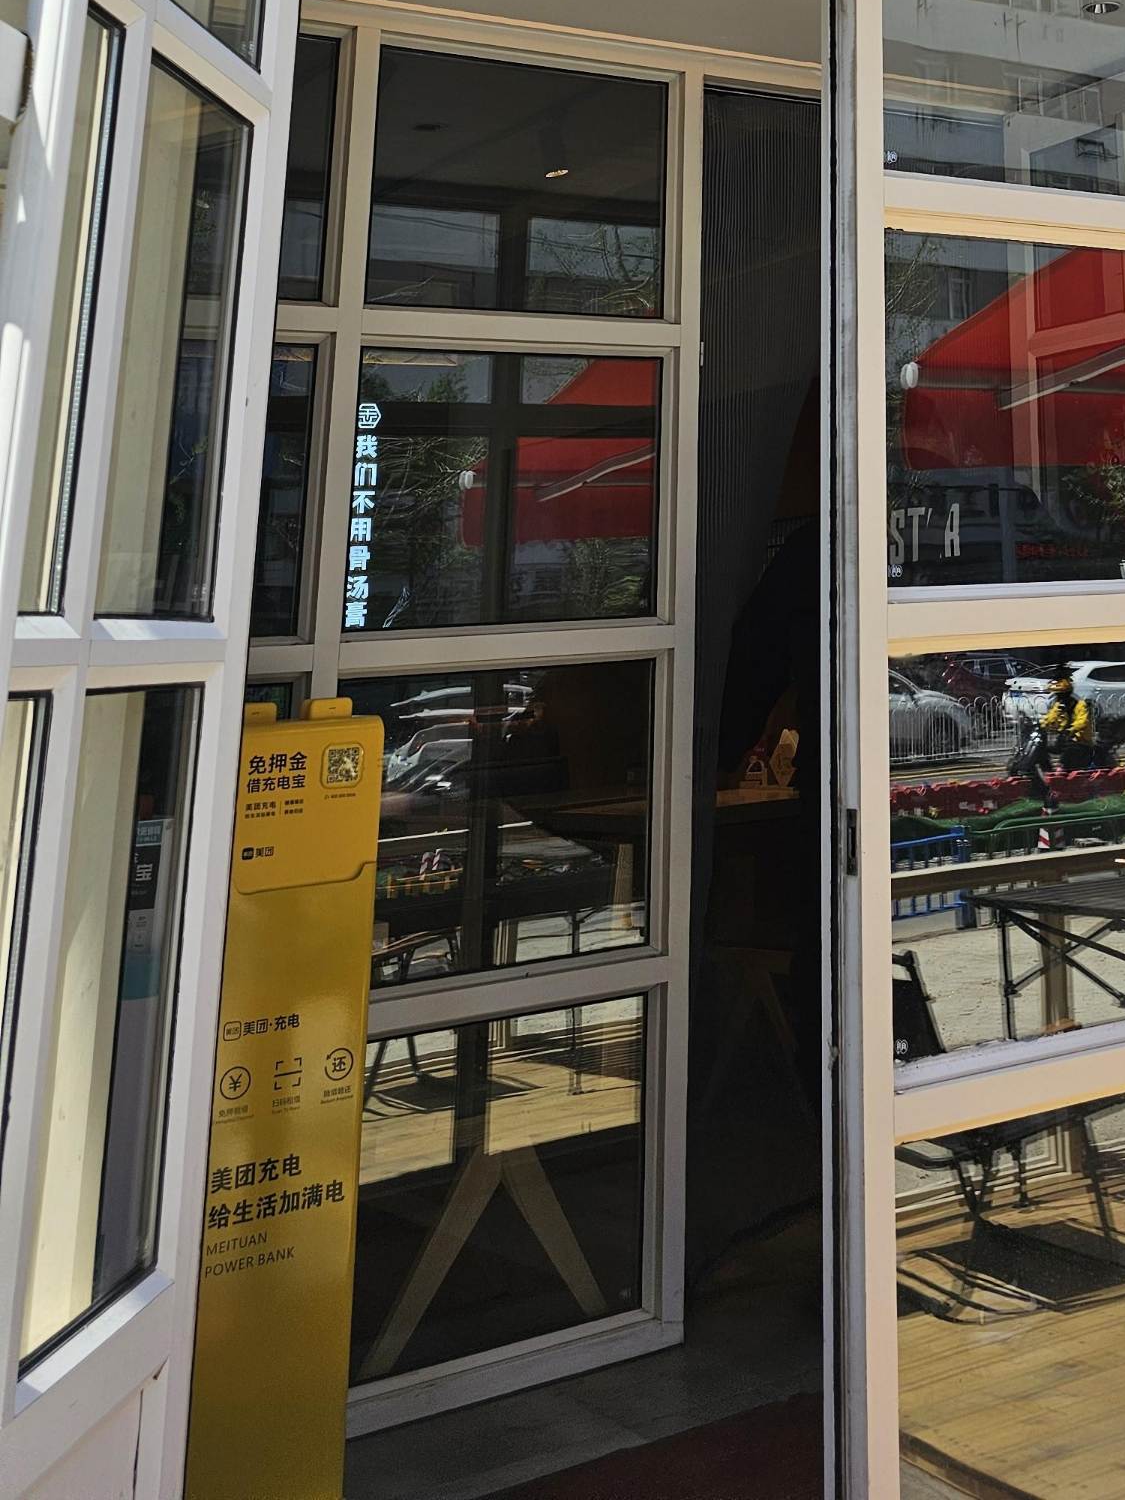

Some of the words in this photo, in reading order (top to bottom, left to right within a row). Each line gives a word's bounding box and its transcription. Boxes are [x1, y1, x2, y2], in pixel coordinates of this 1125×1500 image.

[344, 433, 379, 628] 我们不用骨汤膏
[248, 751, 308, 775] 免押金
[246, 774, 306, 794] 借充电宝
[211, 1153, 302, 1194] 美团充电
[207, 1179, 346, 1230] 给生活加满电
[206, 1231, 268, 1256] MEITUAN
[204, 1256, 255, 1279] POWER
[257, 1246, 296, 1267] BANK
